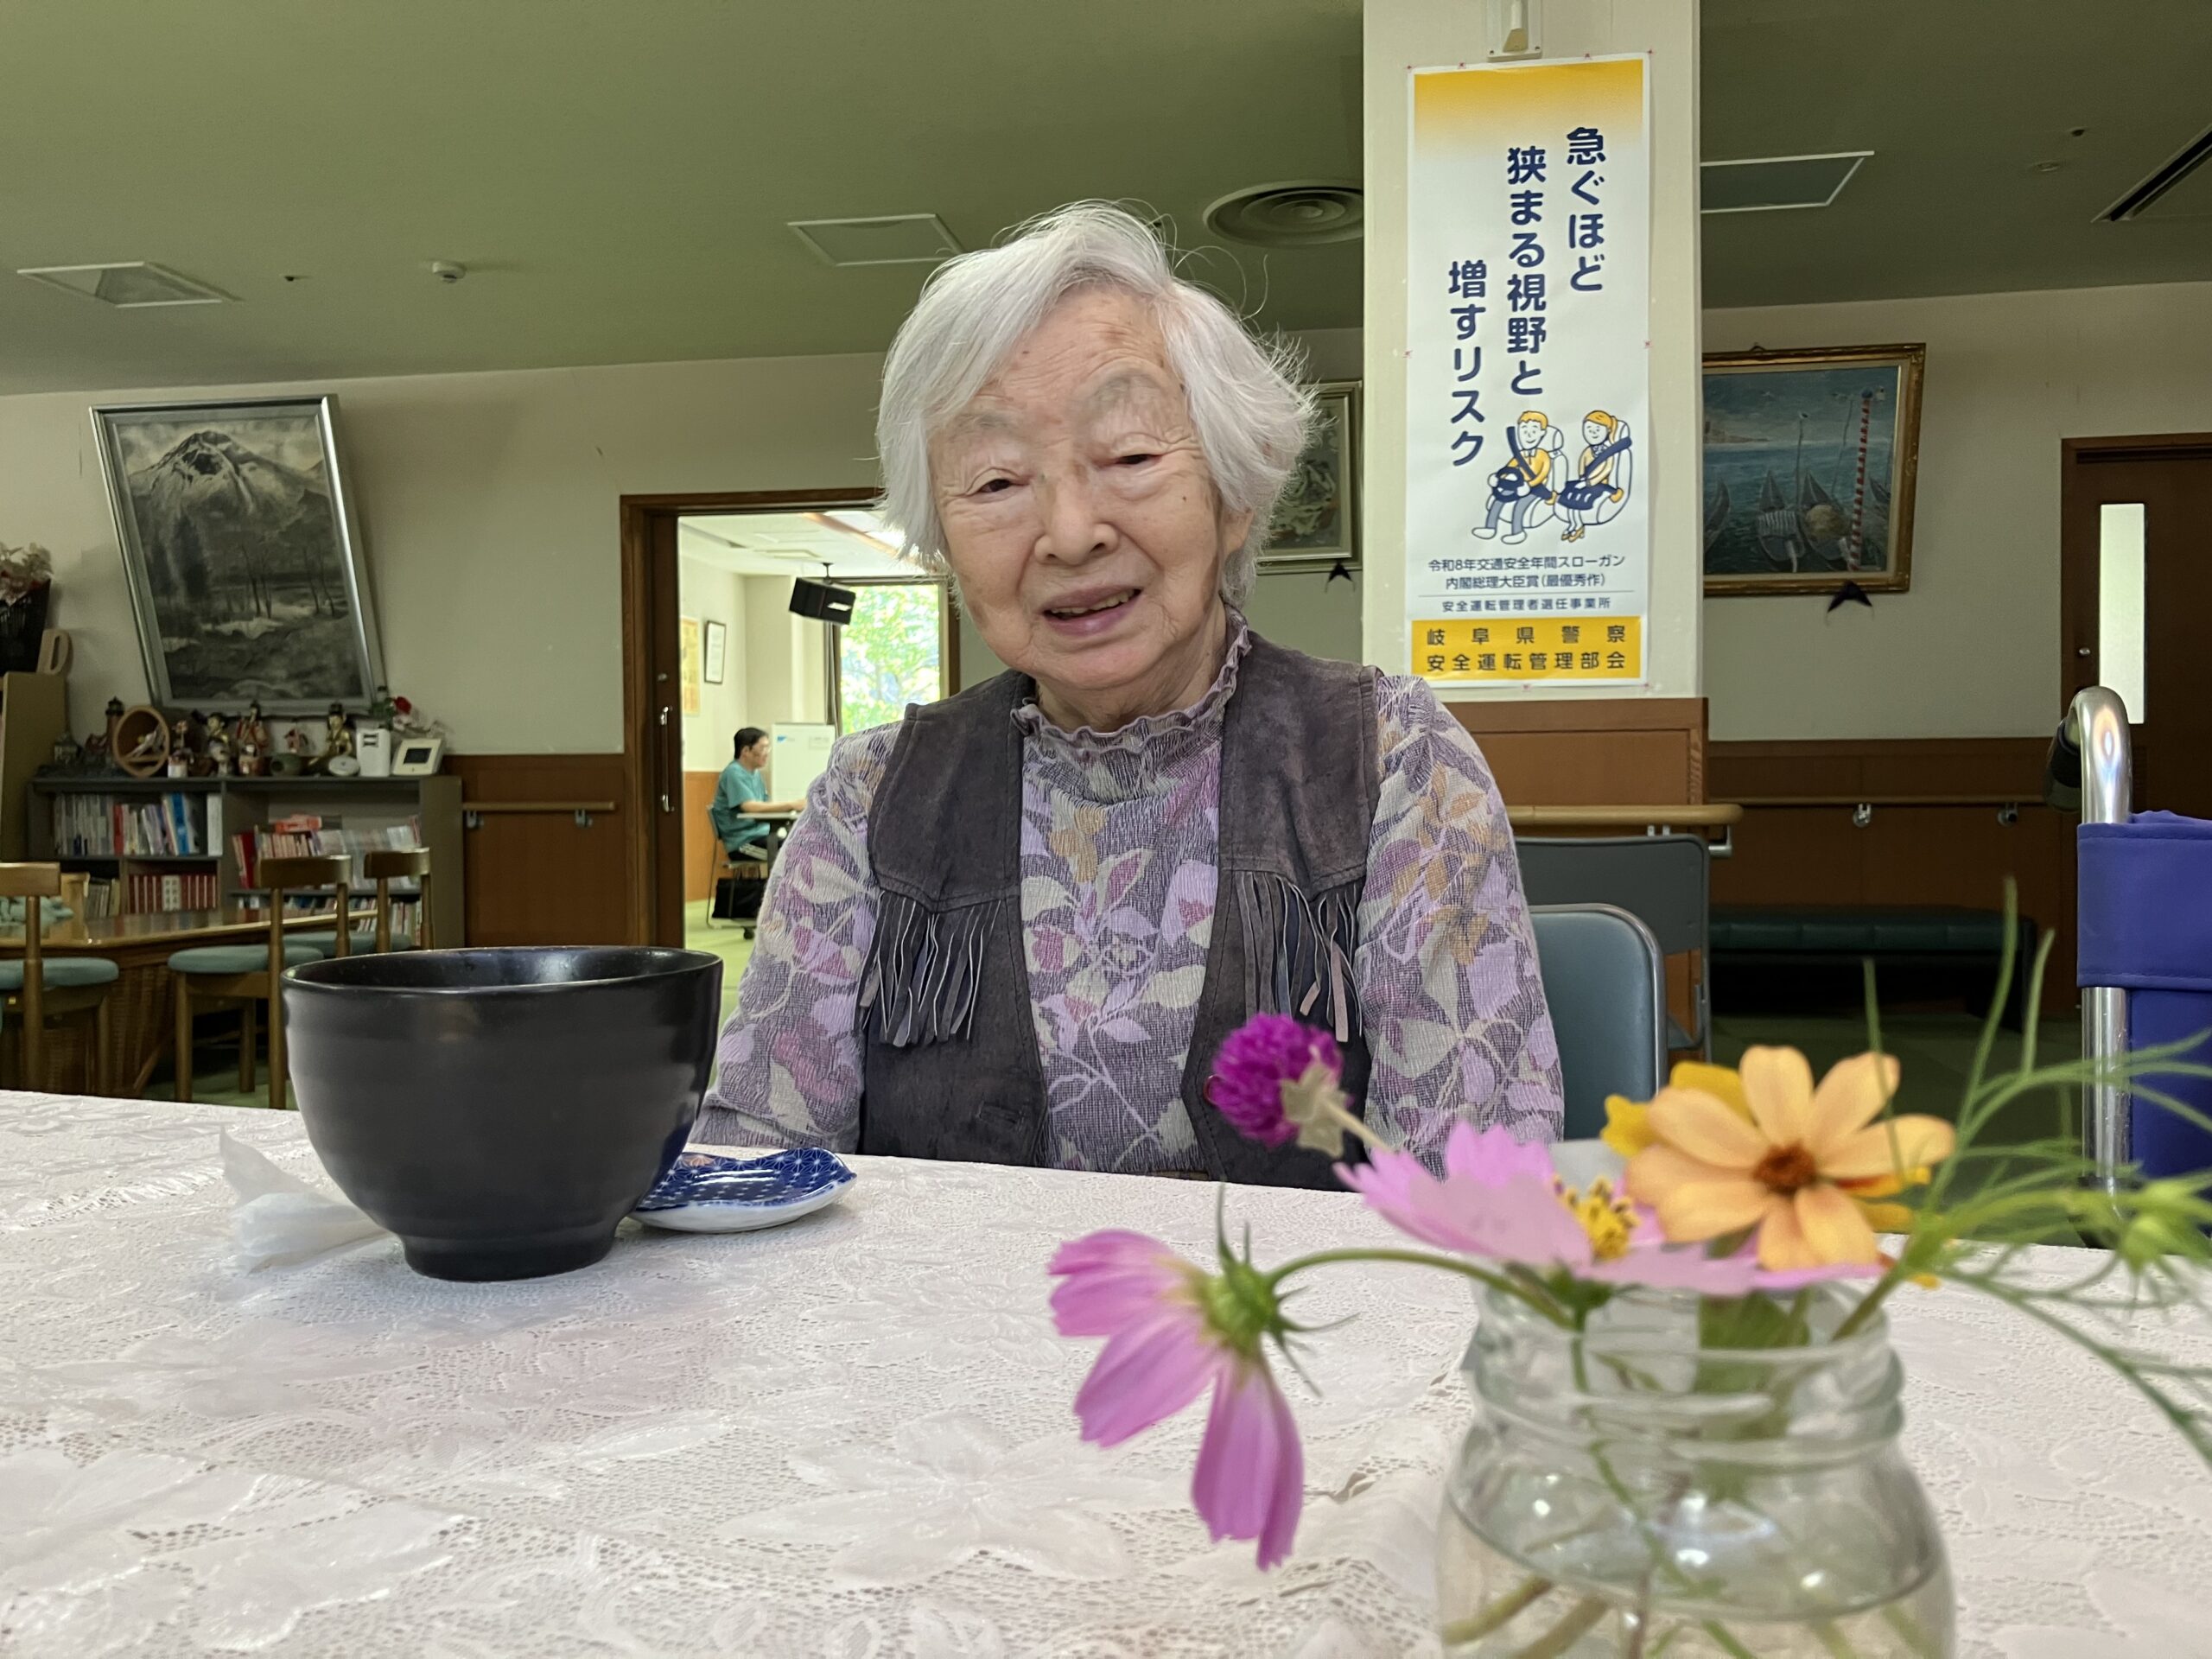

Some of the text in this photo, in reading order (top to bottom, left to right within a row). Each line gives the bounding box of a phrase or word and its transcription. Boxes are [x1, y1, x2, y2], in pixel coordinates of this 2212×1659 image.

[1567, 127, 1606, 291] 急ぐほど
[1507, 146, 1547, 395] 狭まる視野と
[1448, 260, 1487, 466] 増すリスク
[1428, 554, 1625, 571] 令和8年交通安全年間スローガン
[1442, 597, 1611, 612] 安全運転管理者選任事業所
[1427, 625, 1625, 645] 岐阜県警察
[1427, 651, 1625, 671] 安全運転管理部会
